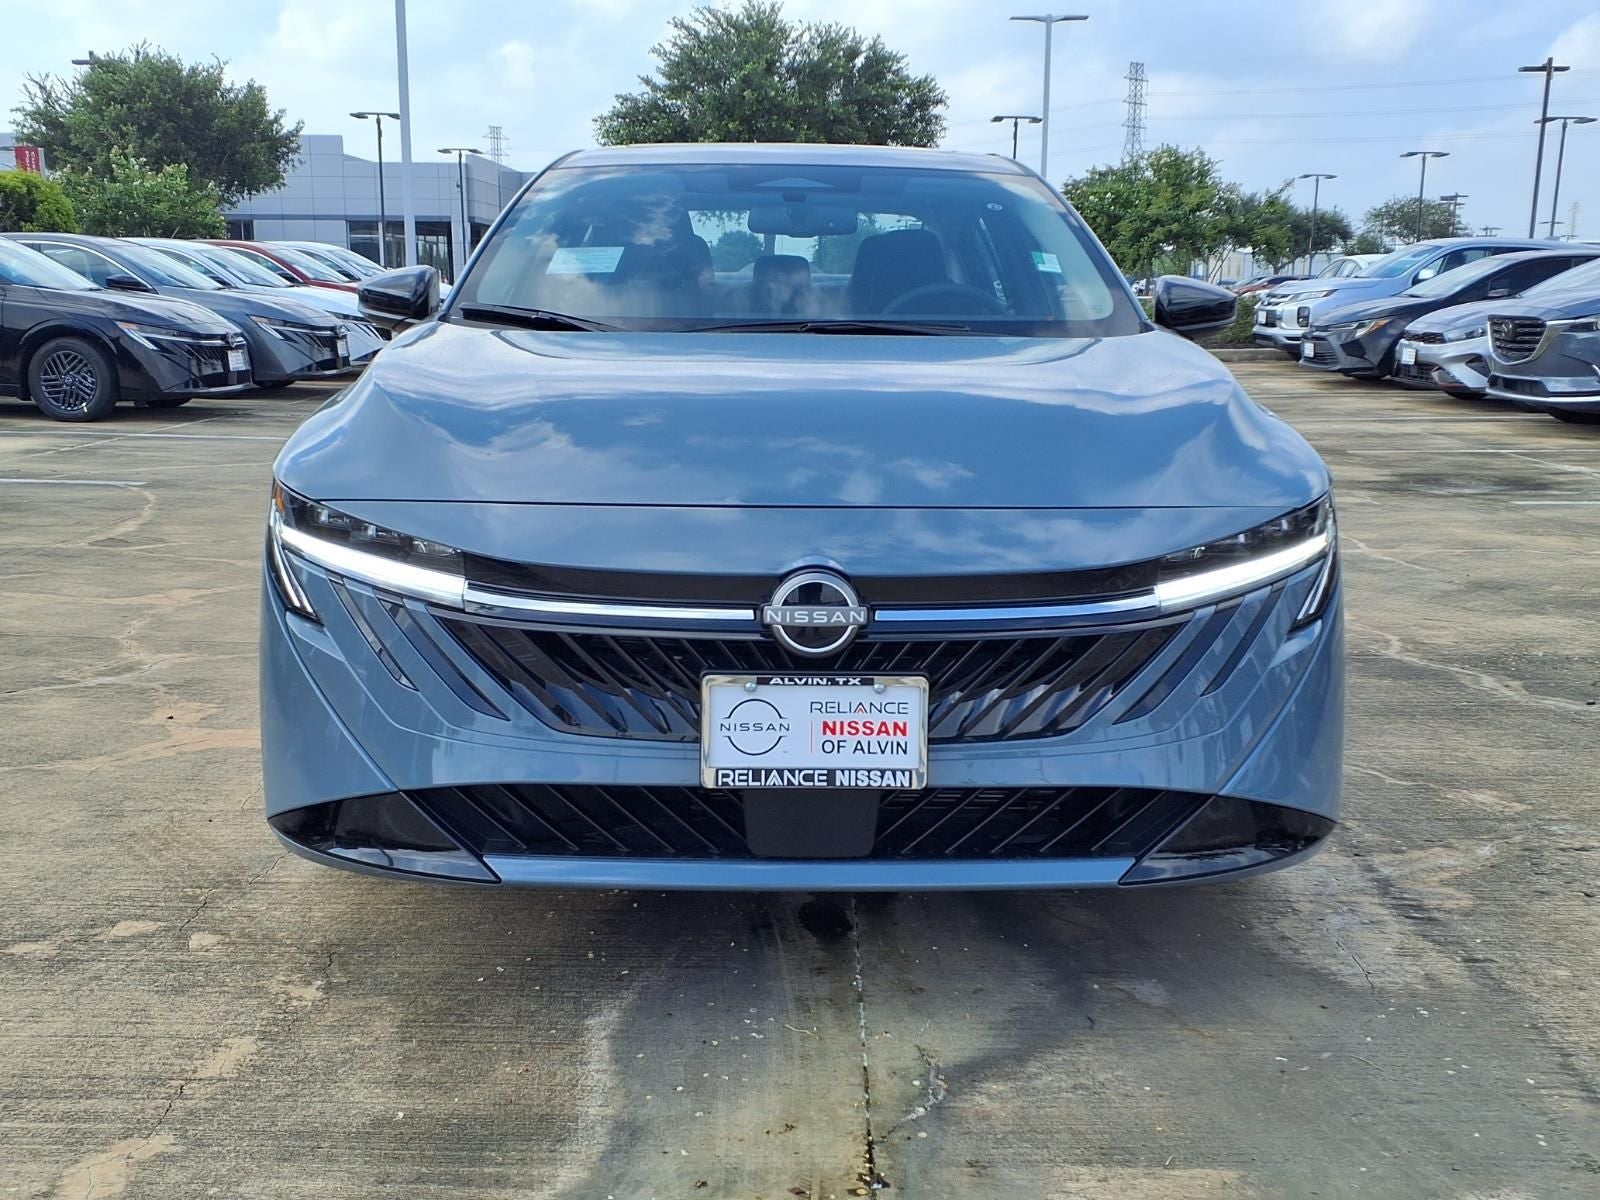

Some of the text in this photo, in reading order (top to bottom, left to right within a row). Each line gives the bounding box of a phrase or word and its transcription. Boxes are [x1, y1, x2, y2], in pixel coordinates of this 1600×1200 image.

[766, 610, 864, 623] NISSAN
[835, 677, 861, 685] TX
[810, 701, 909, 714] RELIANCE
[720, 722, 790, 732] NISSAN
[822, 720, 907, 736] NISSAN
[821, 740, 908, 755] OF ALVIN
[717, 770, 910, 787] RELIANCE NISSAN
